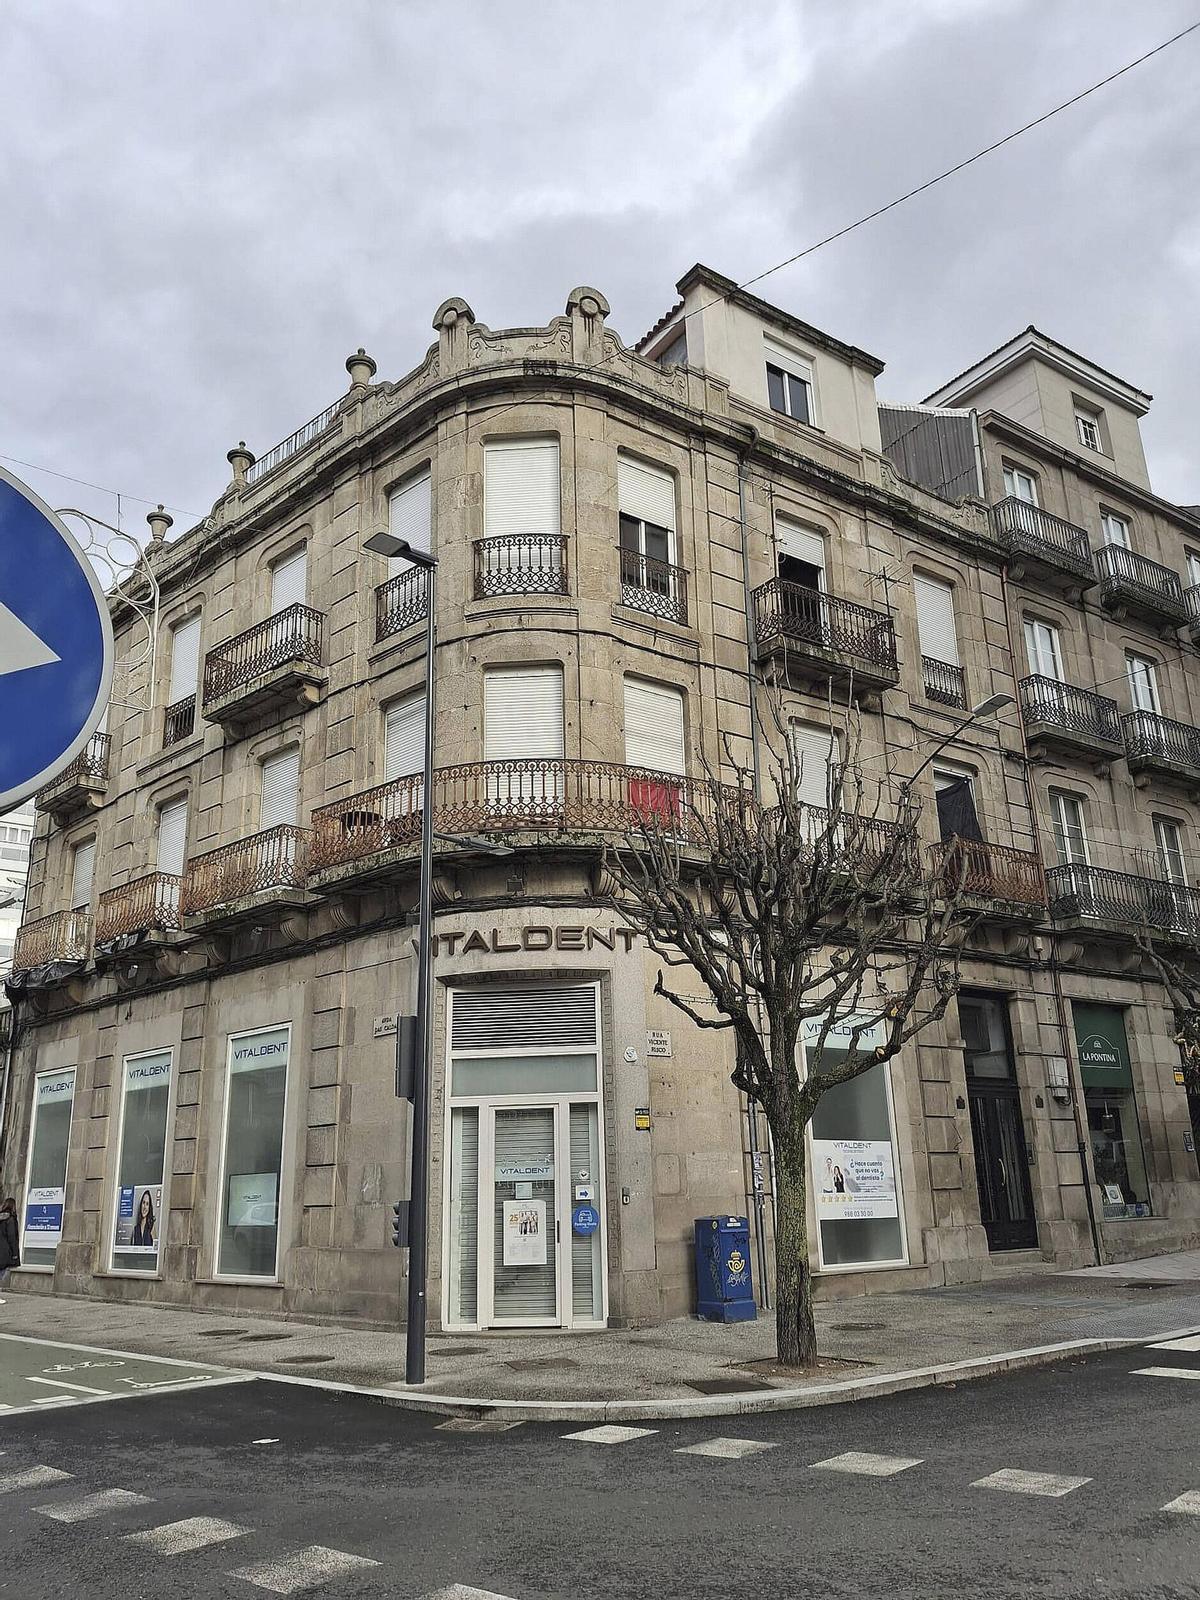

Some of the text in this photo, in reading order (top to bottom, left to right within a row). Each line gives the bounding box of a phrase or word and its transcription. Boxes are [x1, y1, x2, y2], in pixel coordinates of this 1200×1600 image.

[648, 1038, 669, 1046] VICENTE
[234, 1042, 288, 1059] VITALDENT
[1082, 1051, 1091, 1061] LA
[129, 1064, 171, 1078] VITALDENT
[40, 1081, 74, 1093] VITALDENT
[500, 1167, 550, 1175] VITALDENT
[509, 1214, 519, 1222] 25
